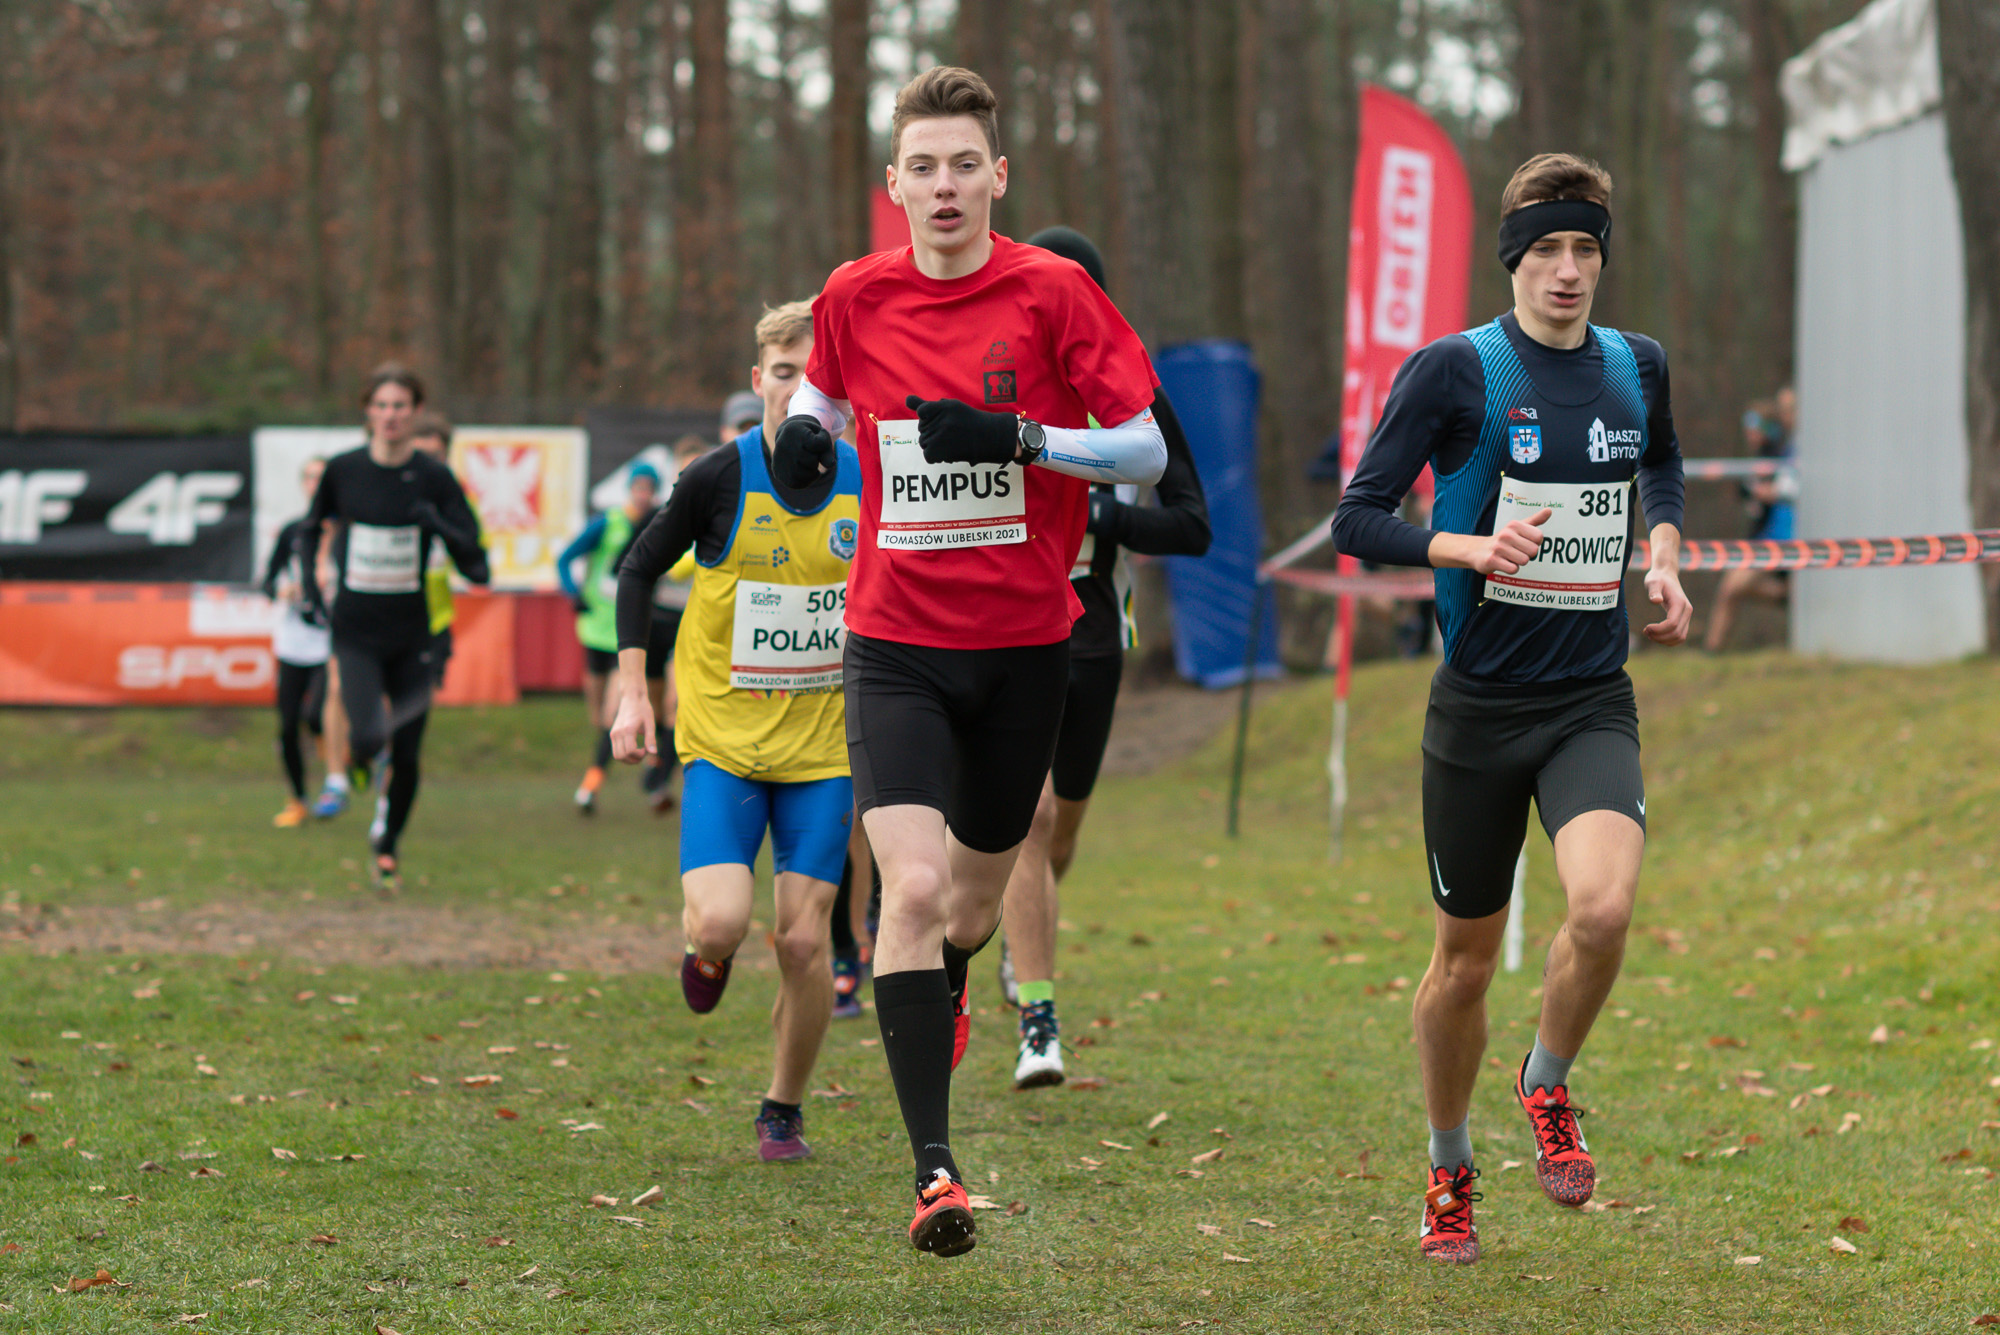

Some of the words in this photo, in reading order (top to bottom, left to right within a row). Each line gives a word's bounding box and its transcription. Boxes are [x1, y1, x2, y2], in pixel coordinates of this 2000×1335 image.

[1508, 407, 1538, 420] esa
[1607, 430, 1641, 443] BASZTA
[892, 463, 1011, 503] PEMPUŚ
[107, 471, 243, 545] 4F
[1578, 488, 1622, 517] 381
[885, 532, 944, 545] TOMASZÓW
[947, 530, 992, 543] LUBELSKI
[996, 528, 1020, 540] 2021
[1529, 535, 1623, 564] PROWICZ
[806, 588, 846, 613] 509
[1492, 586, 1556, 604] TOMASZÓW
[1558, 595, 1600, 606] LUBELSKI
[737, 675, 790, 686] TOMASZÓW
[793, 674, 829, 685] LUBELSKI
